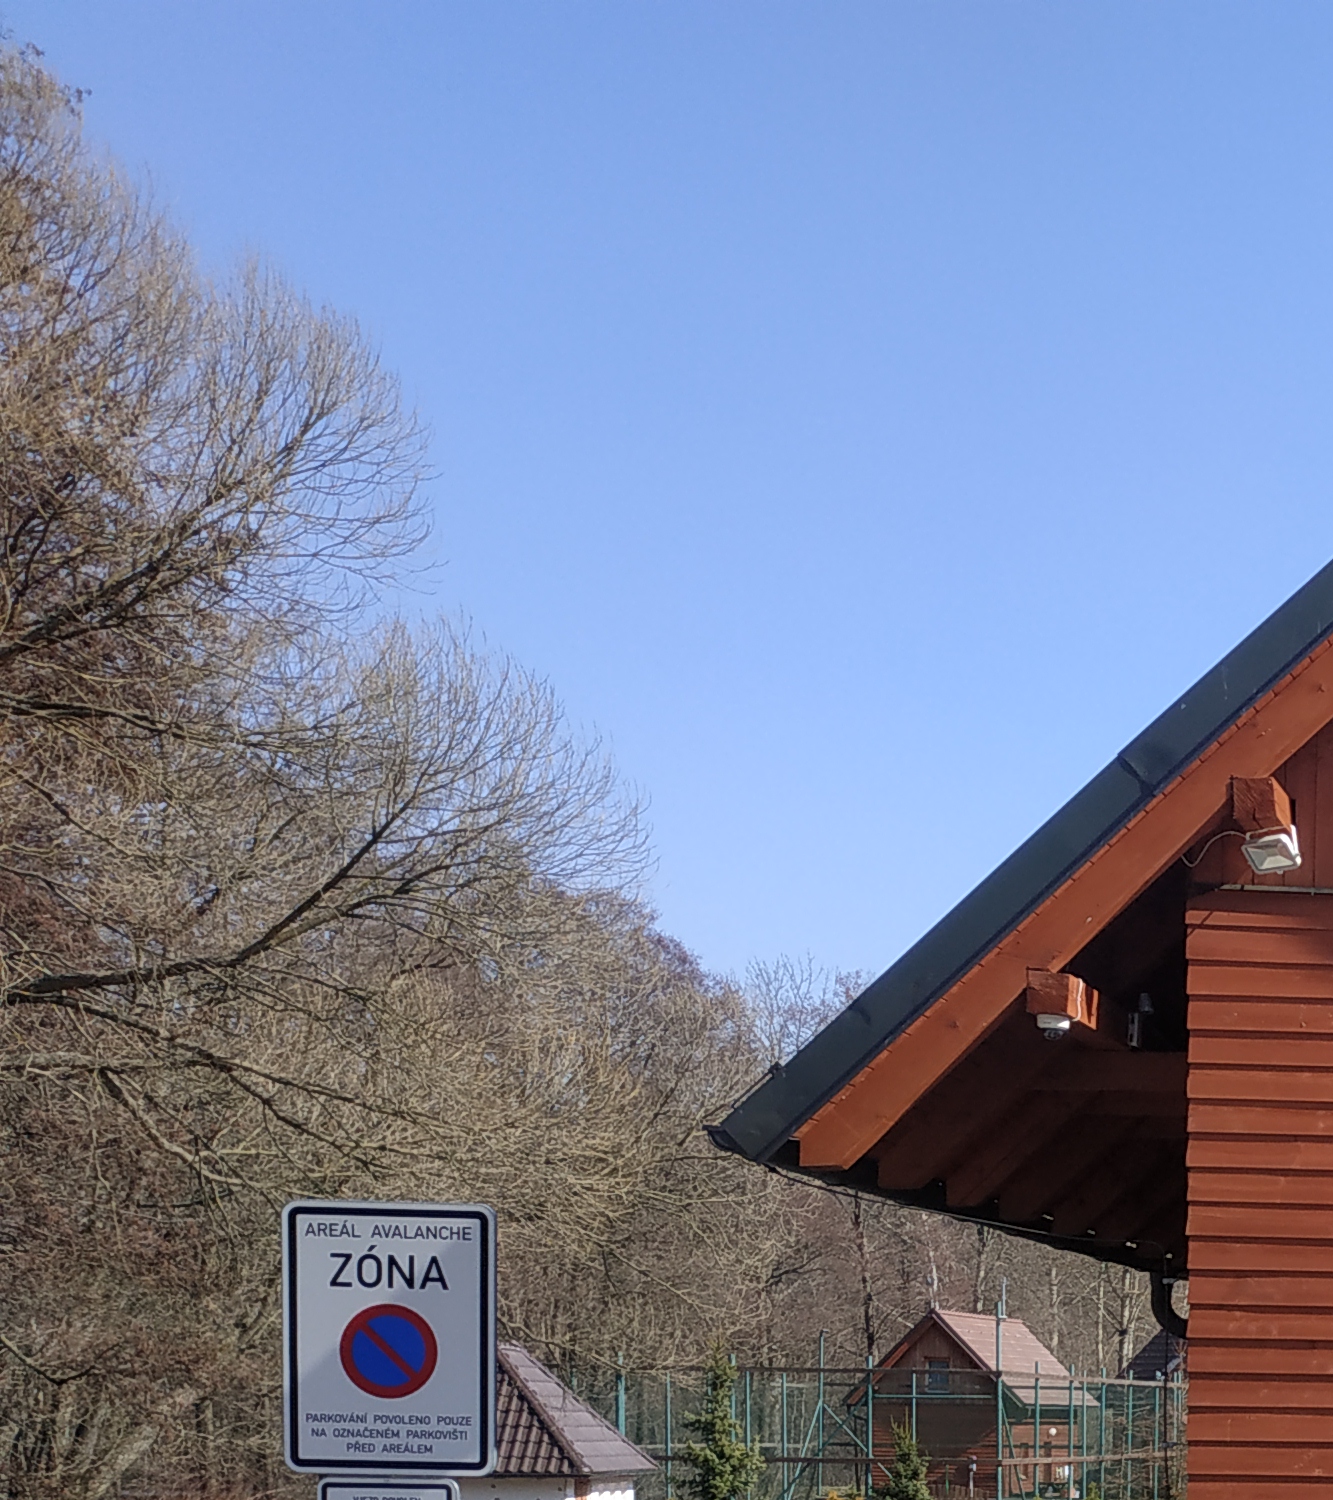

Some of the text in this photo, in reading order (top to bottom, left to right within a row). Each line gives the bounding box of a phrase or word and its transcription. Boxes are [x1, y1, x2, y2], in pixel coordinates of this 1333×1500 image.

[305, 1220, 473, 1241] AREÁL AVALANCHE
[329, 1244, 450, 1291] ZÓNA
[305, 1412, 472, 1426] PARKOVÁNÍ POVOLENO POUZE
[311, 1427, 468, 1441] NA OZNAČENÉM PARKOVIŠTI
[346, 1442, 433, 1454] PŘED AREÁLEM
